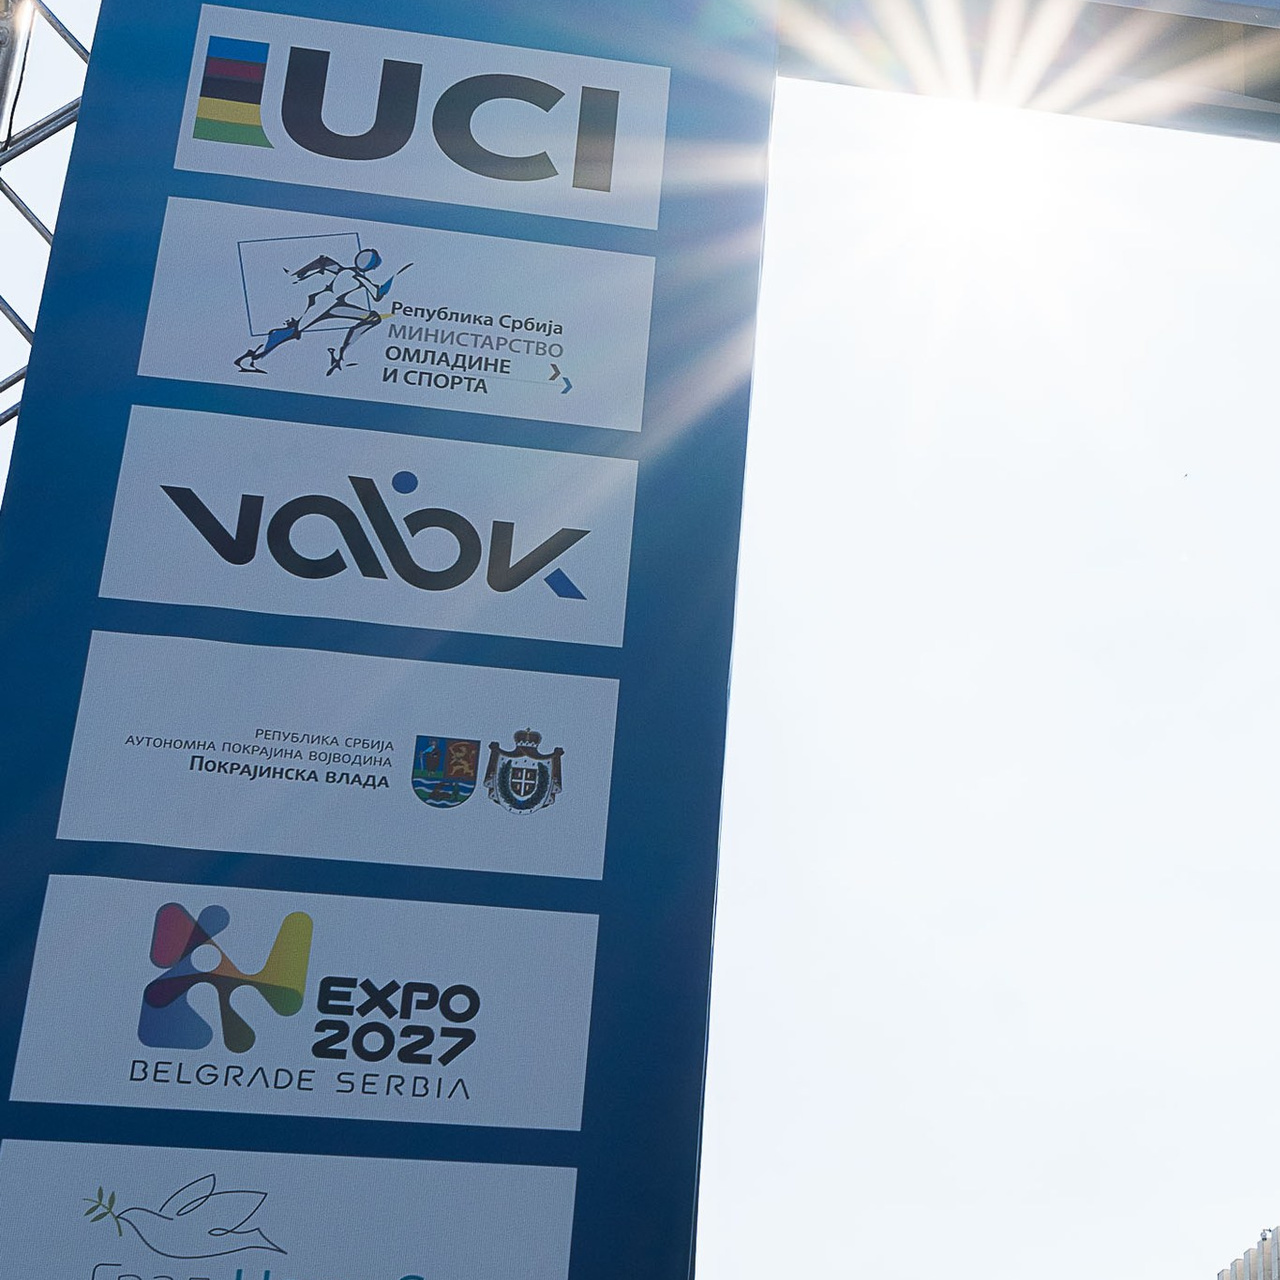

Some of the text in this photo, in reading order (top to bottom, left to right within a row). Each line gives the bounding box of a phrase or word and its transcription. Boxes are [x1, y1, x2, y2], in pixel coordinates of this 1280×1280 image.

[281, 46, 620, 193] UCI
[391, 301, 563, 336] Република Србија
[387, 323, 563, 358] МИНИСТАРСТВО
[385, 345, 511, 374] ОМЛАДИНЕ
[382, 367, 488, 394] И СПОРТА
[125, 733, 392, 768] АУТОНОМНА ПОКРАЈИНА ВОЈВОДИНА
[255, 728, 394, 752] РЕПУБЛИКА СРБИЈА
[317, 976, 480, 1022] EXPO
[311, 1019, 477, 1067] 2027
[129, 1059, 470, 1100] BELGRADE SERBIA
